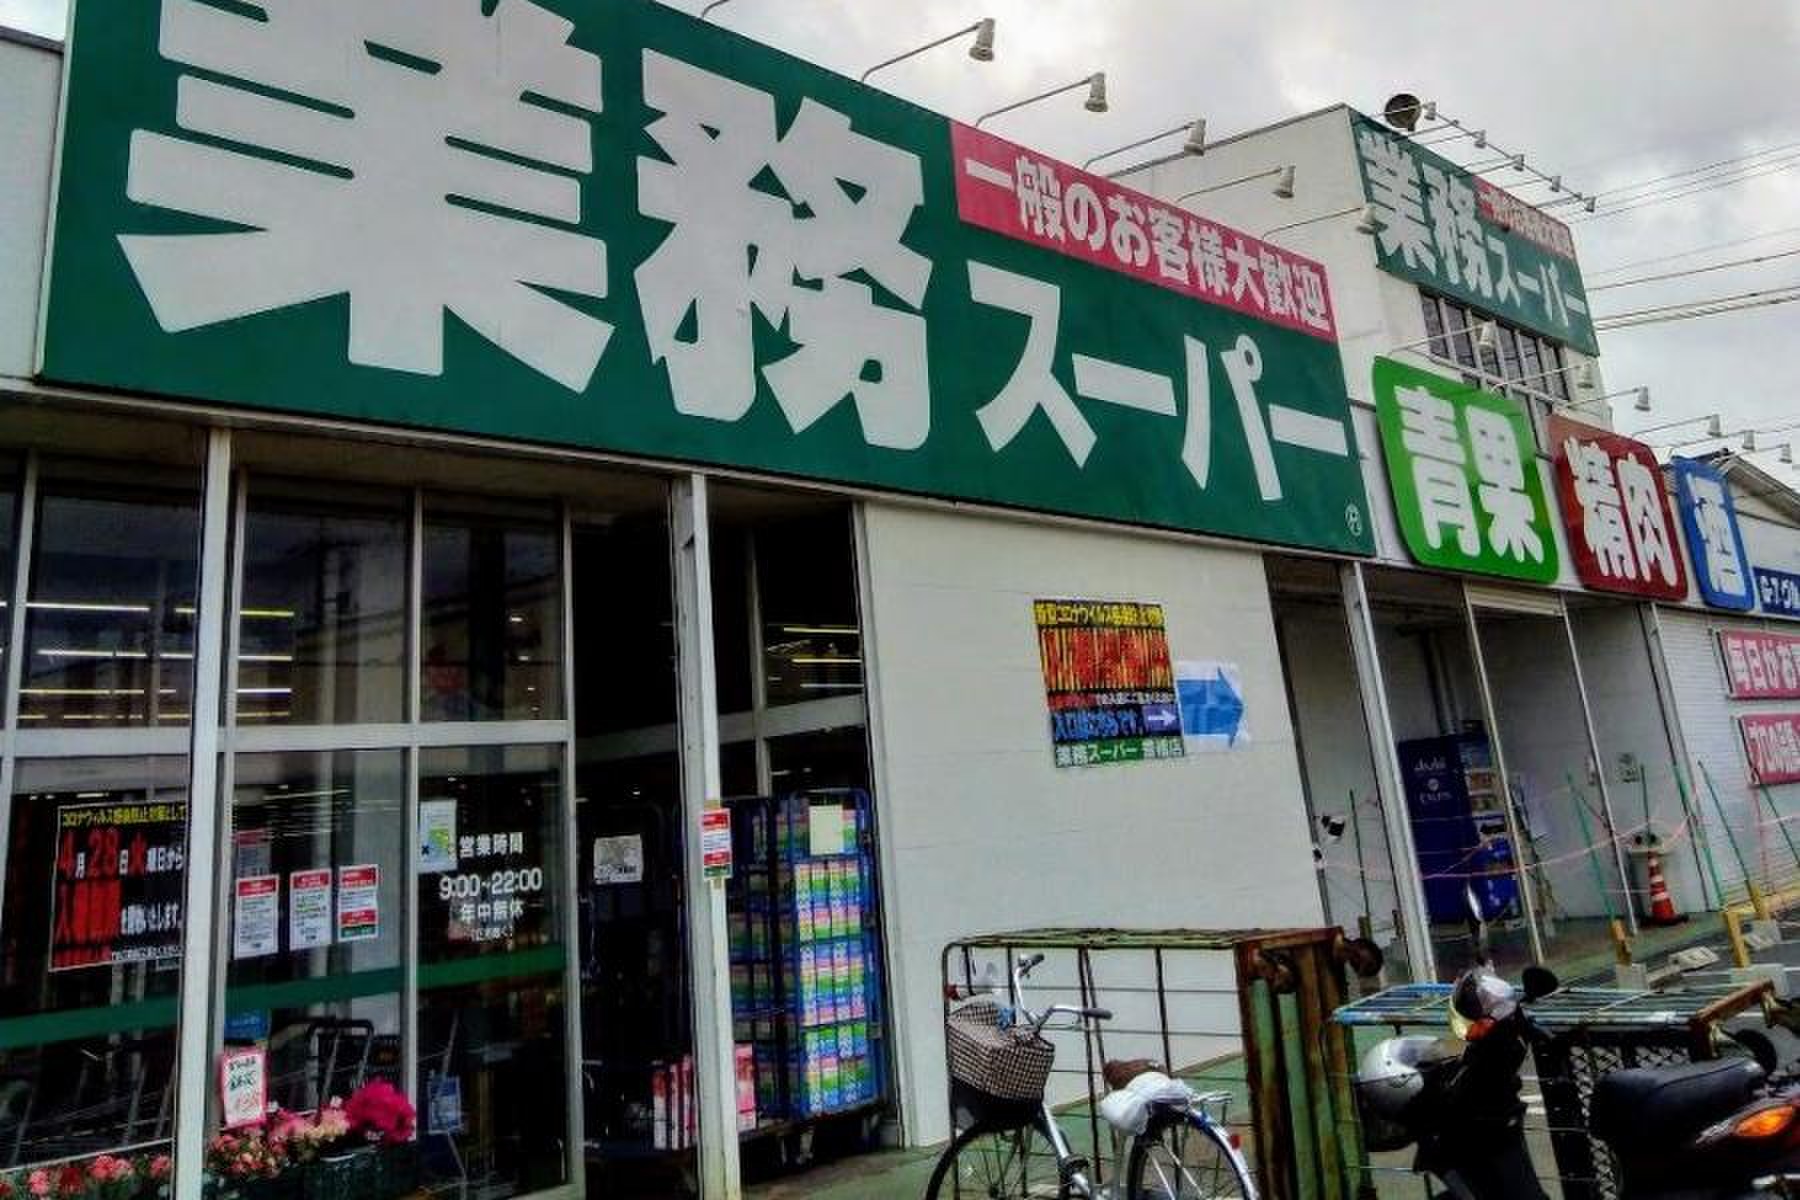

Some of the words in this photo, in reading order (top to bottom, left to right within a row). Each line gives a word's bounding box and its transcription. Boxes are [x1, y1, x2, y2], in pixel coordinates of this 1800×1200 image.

[965, 154, 1331, 334] 一般のお客様大歓迎
[1359, 129, 1587, 327] 業務スーパー
[1394, 385, 1544, 562] 青果
[1563, 436, 1678, 588] 精肉
[1686, 472, 1746, 596] 酒
[458, 831, 524, 858] 営業時間
